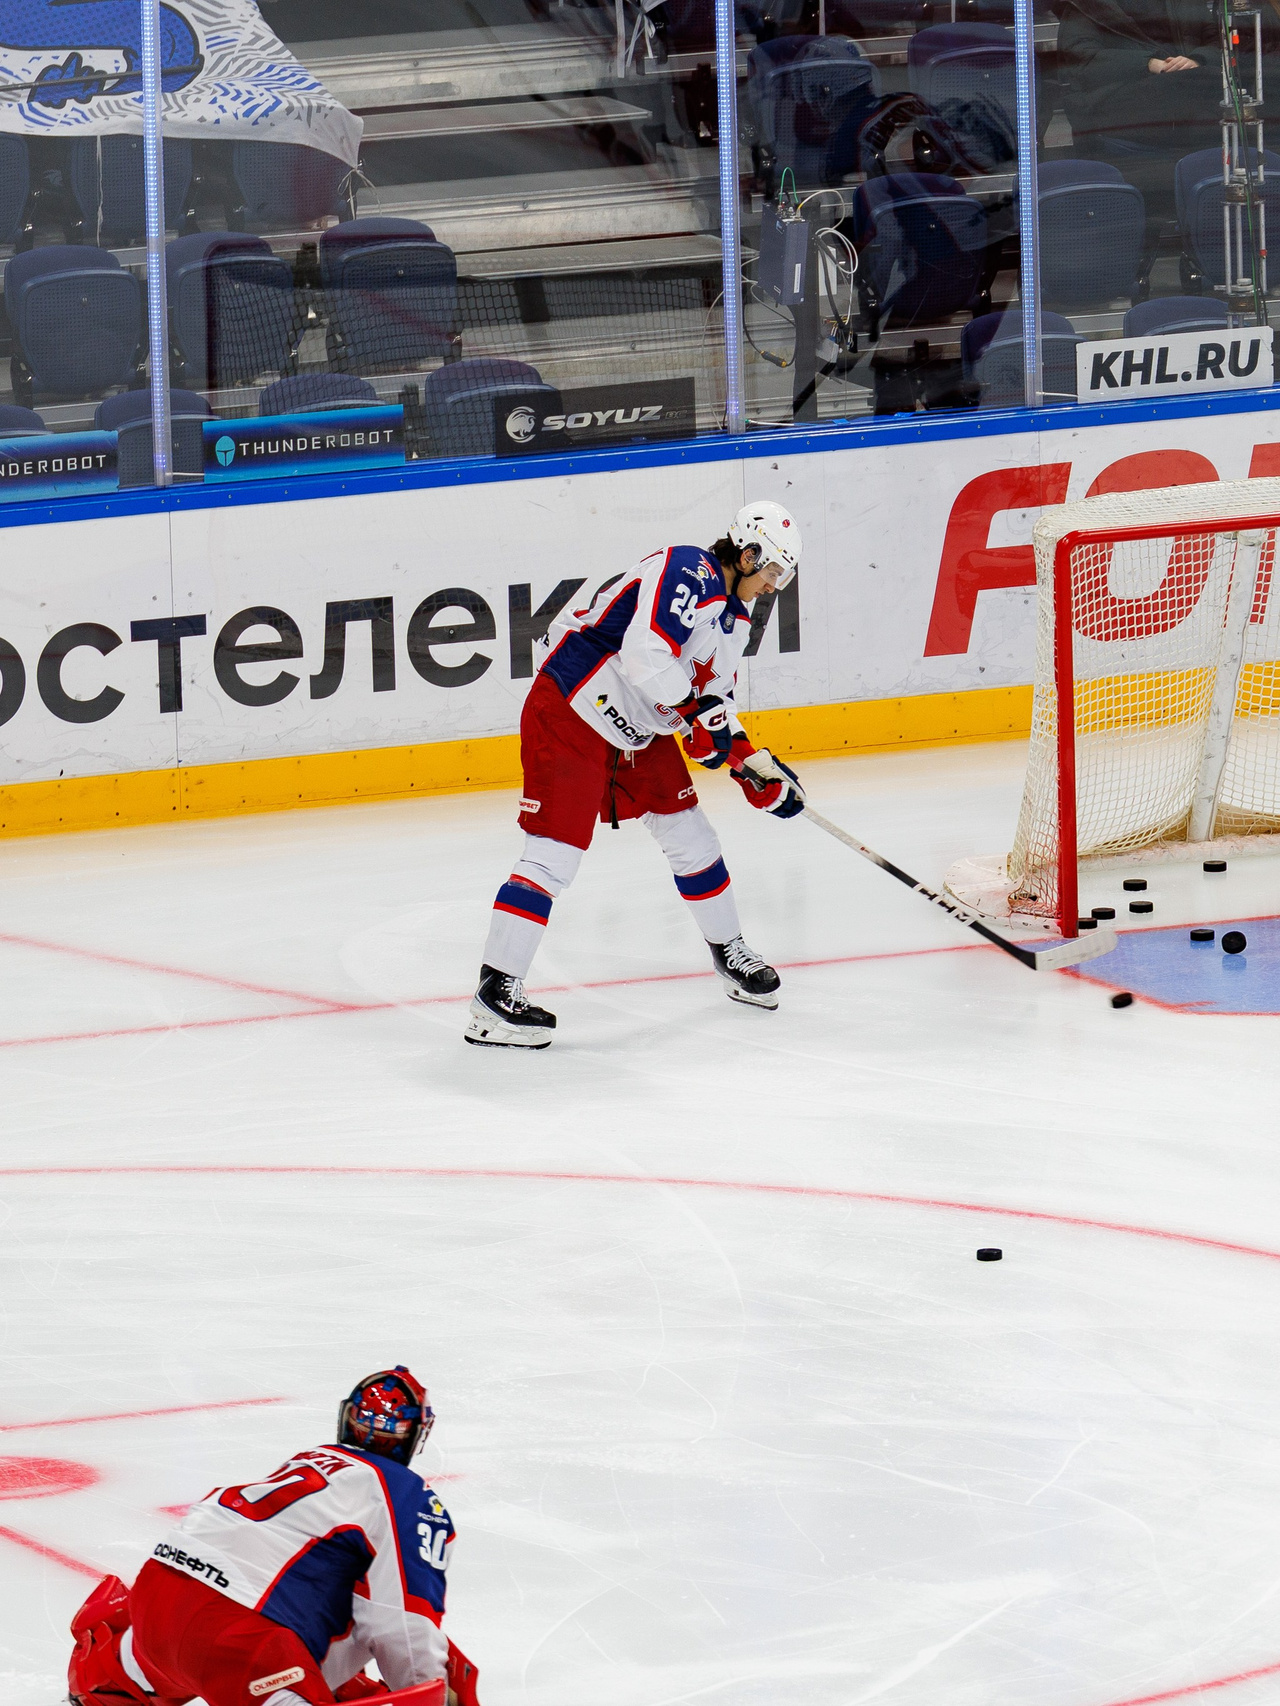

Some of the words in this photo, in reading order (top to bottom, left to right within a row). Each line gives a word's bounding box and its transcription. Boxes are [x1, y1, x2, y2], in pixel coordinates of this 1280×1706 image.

[1090, 338, 1261, 390] KHL.RU
[541, 405, 663, 431] SOYUZ
[239, 429, 394, 456] THUNDEROBOT
[670, 583, 699, 629] 28
[154, 1543, 230, 1589] ОСНЕФТЬ
[417, 1522, 448, 1571] 30
[253, 1670, 301, 1692] OLIMPBET
